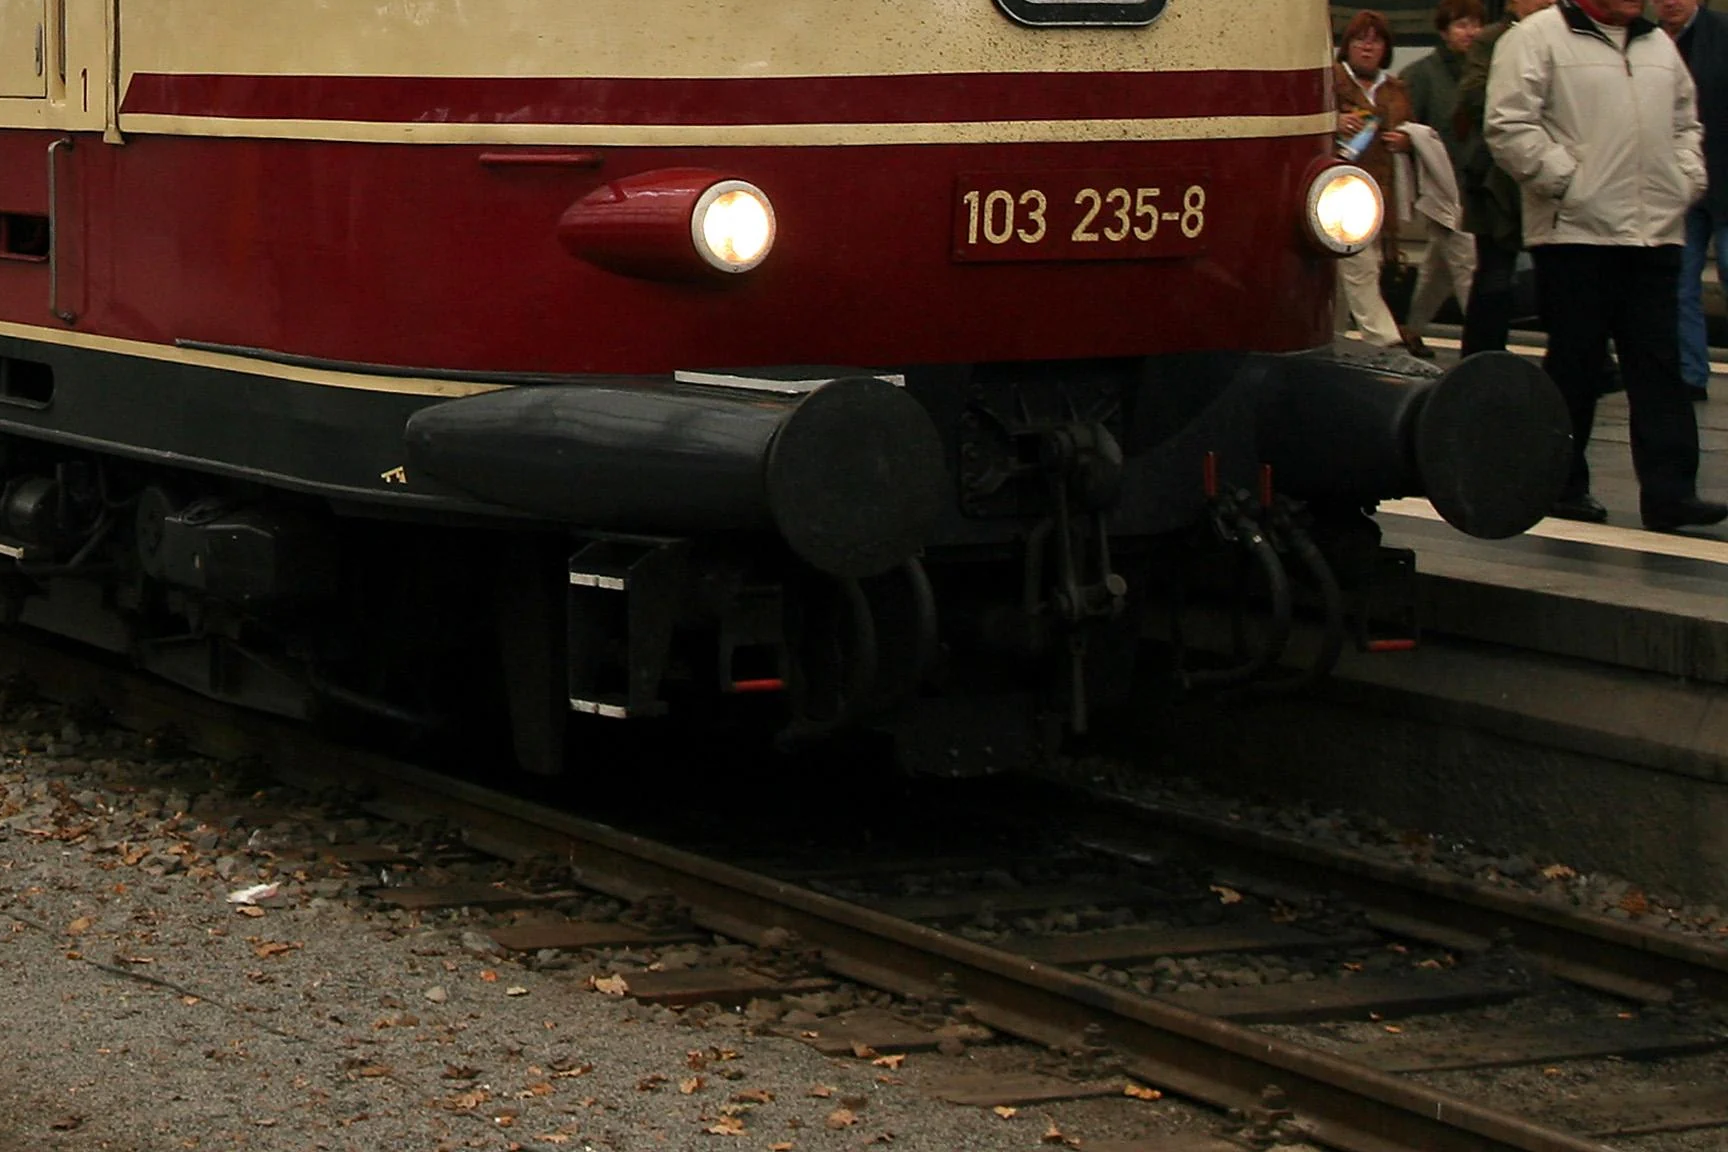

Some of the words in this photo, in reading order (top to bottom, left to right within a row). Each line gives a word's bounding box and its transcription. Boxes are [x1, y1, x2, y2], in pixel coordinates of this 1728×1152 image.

[80, 67, 88, 112] 1
[962, 188, 1047, 245] 103
[1071, 184, 1206, 242] 235-8
